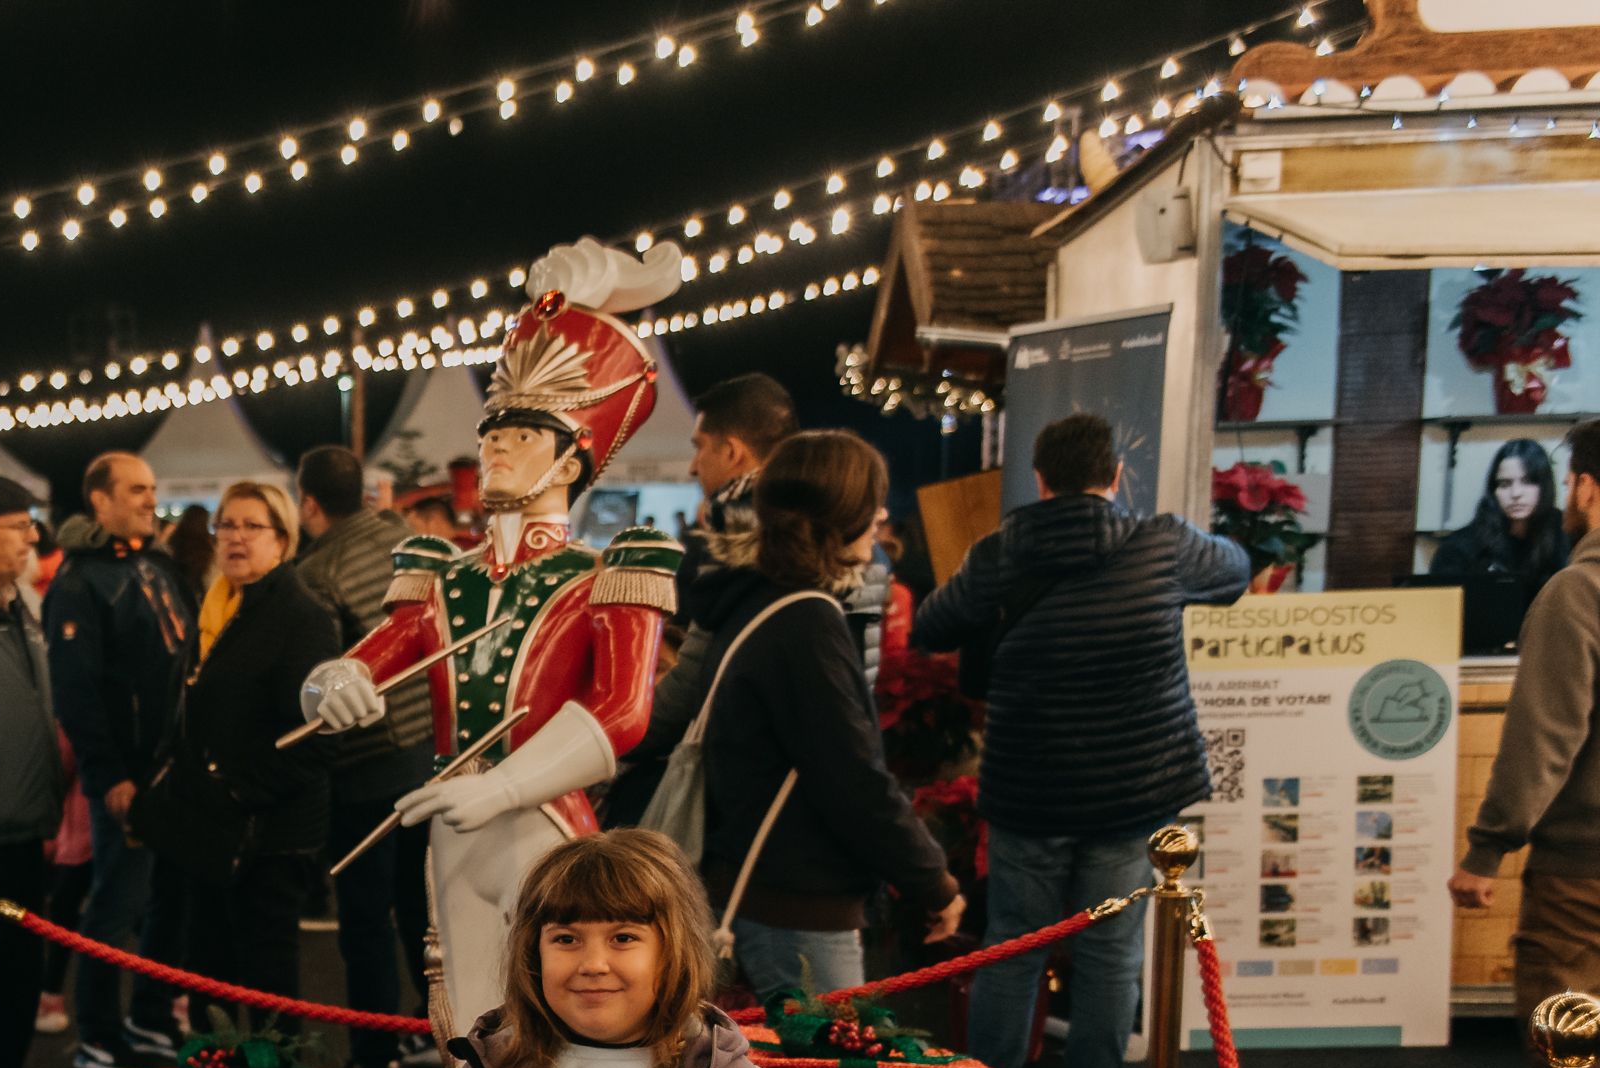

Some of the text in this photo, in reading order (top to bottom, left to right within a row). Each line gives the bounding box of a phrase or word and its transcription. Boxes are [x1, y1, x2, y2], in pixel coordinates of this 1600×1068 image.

[1190, 604, 1397, 629] PRESSUPOSTOS
[1216, 679, 1280, 692] ARRIBAT
[1250, 696, 1271, 707] DE
